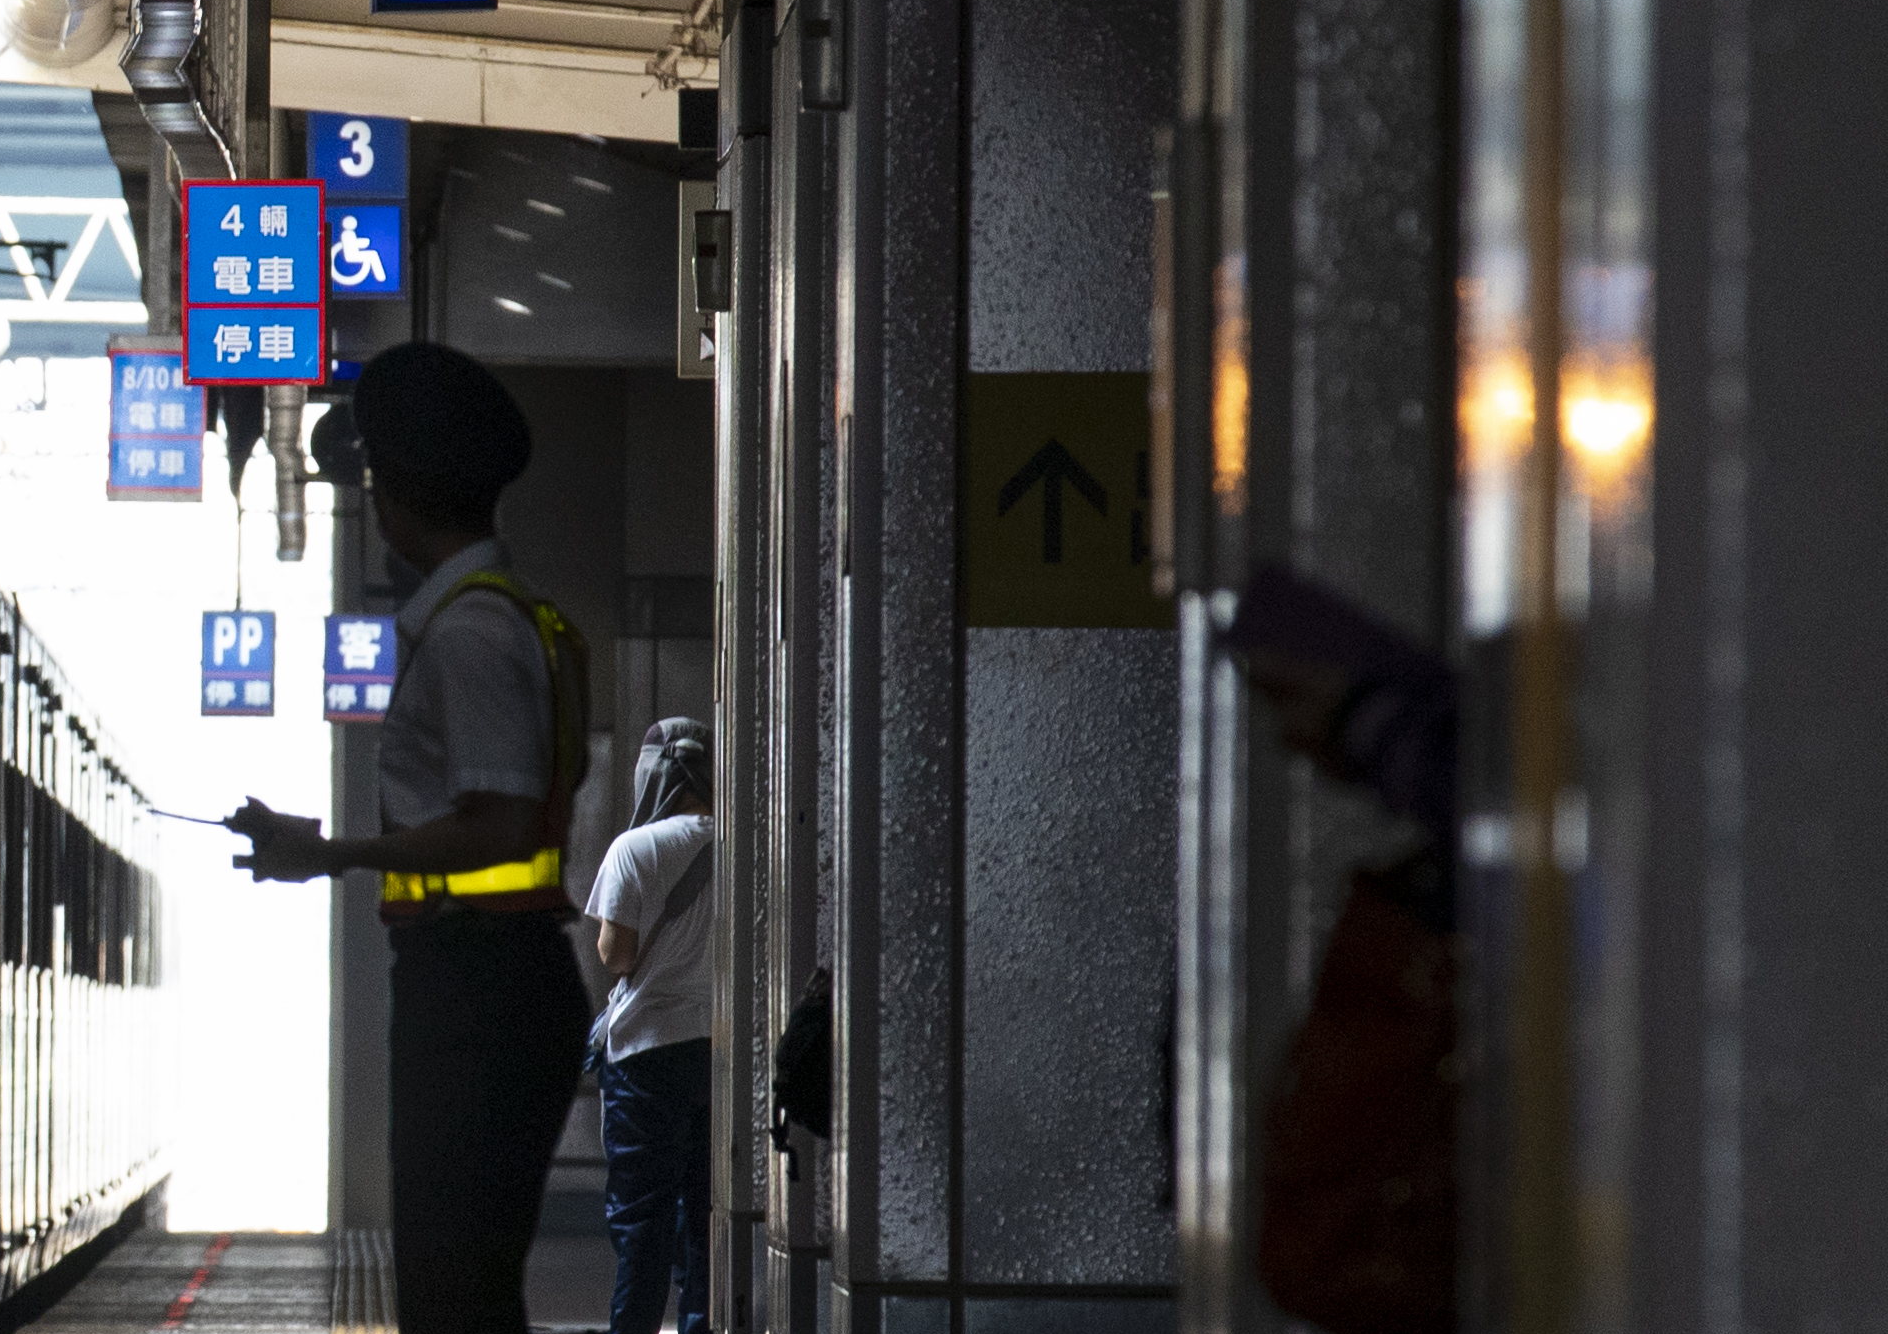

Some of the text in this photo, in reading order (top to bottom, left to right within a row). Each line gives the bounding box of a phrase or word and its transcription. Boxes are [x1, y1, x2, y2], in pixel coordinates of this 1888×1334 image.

[338, 120, 375, 178] 3
[220, 204, 245, 236] 4
[213, 255, 295, 295] 電車
[213, 324, 295, 363] 停車
[128, 403, 185, 430] 電車
[128, 449, 185, 476] 停車
[213, 616, 263, 666] PP
[338, 621, 382, 670] 客
